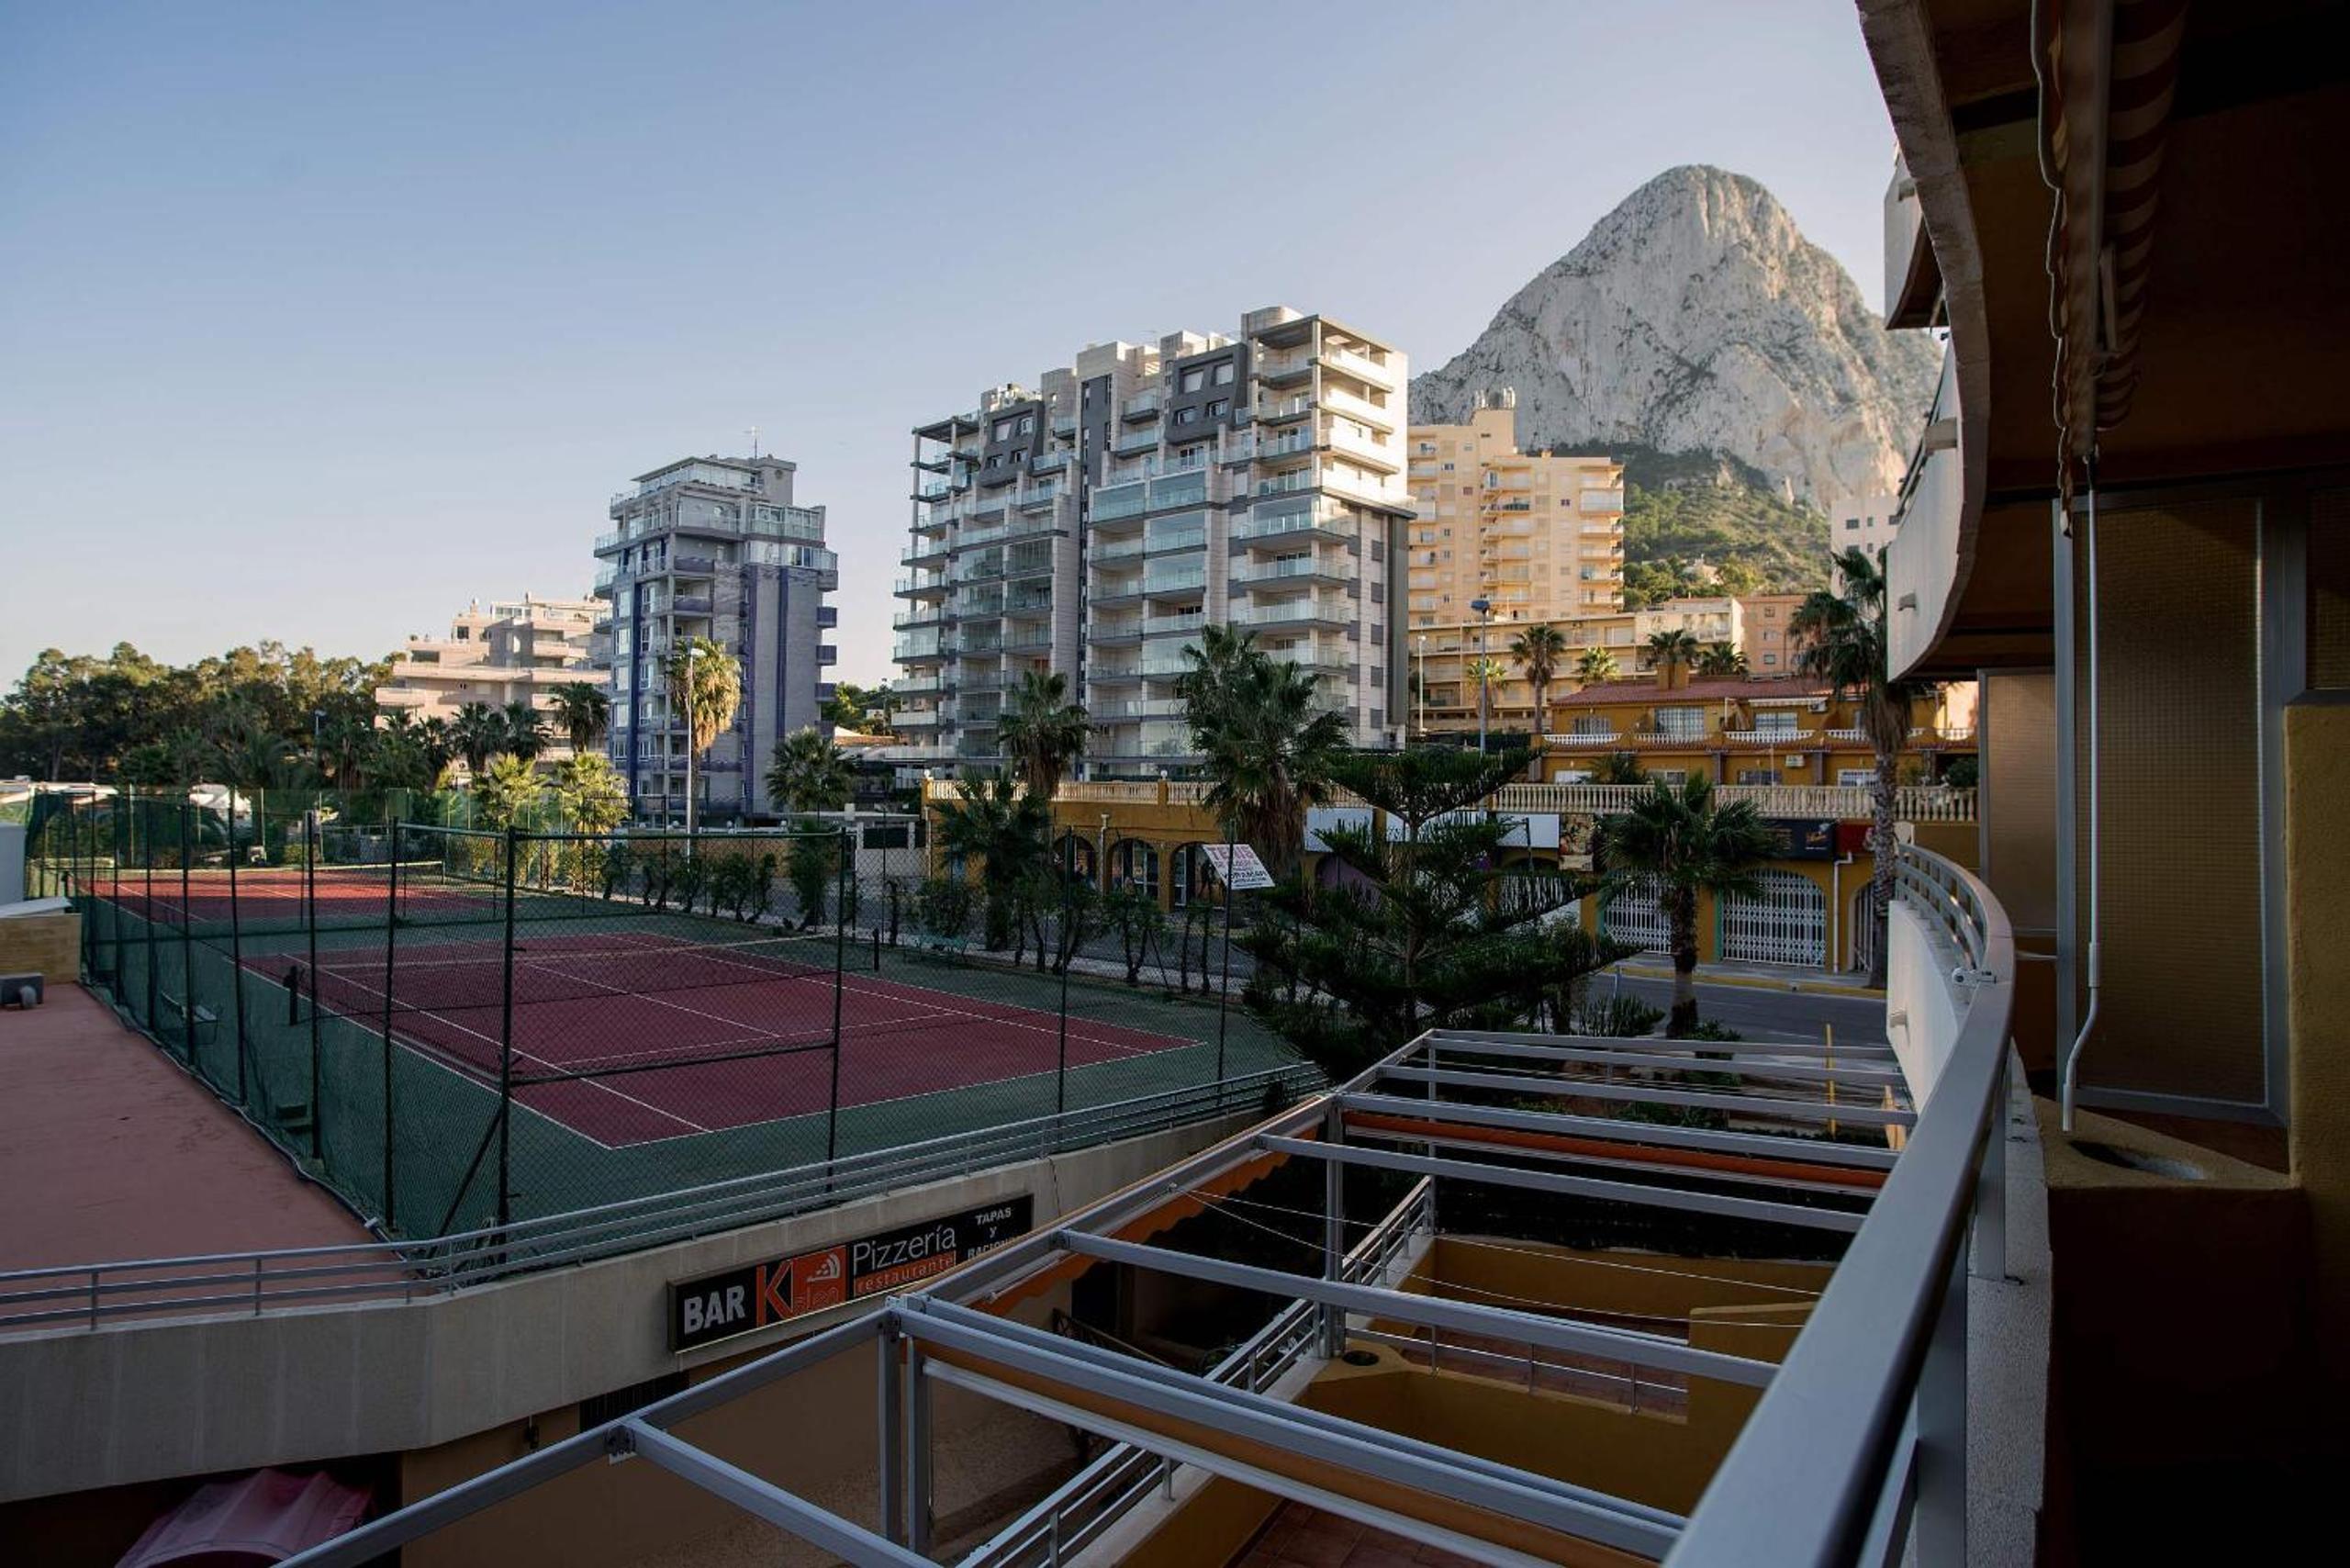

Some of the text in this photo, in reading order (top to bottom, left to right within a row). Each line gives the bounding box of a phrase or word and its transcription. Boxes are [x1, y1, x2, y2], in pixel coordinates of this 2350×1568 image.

[975, 1207, 1011, 1226] TAPAS
[853, 1225, 957, 1275] Pizzería
[856, 1257, 954, 1294] restaurante
[684, 1285, 746, 1335] BAR
